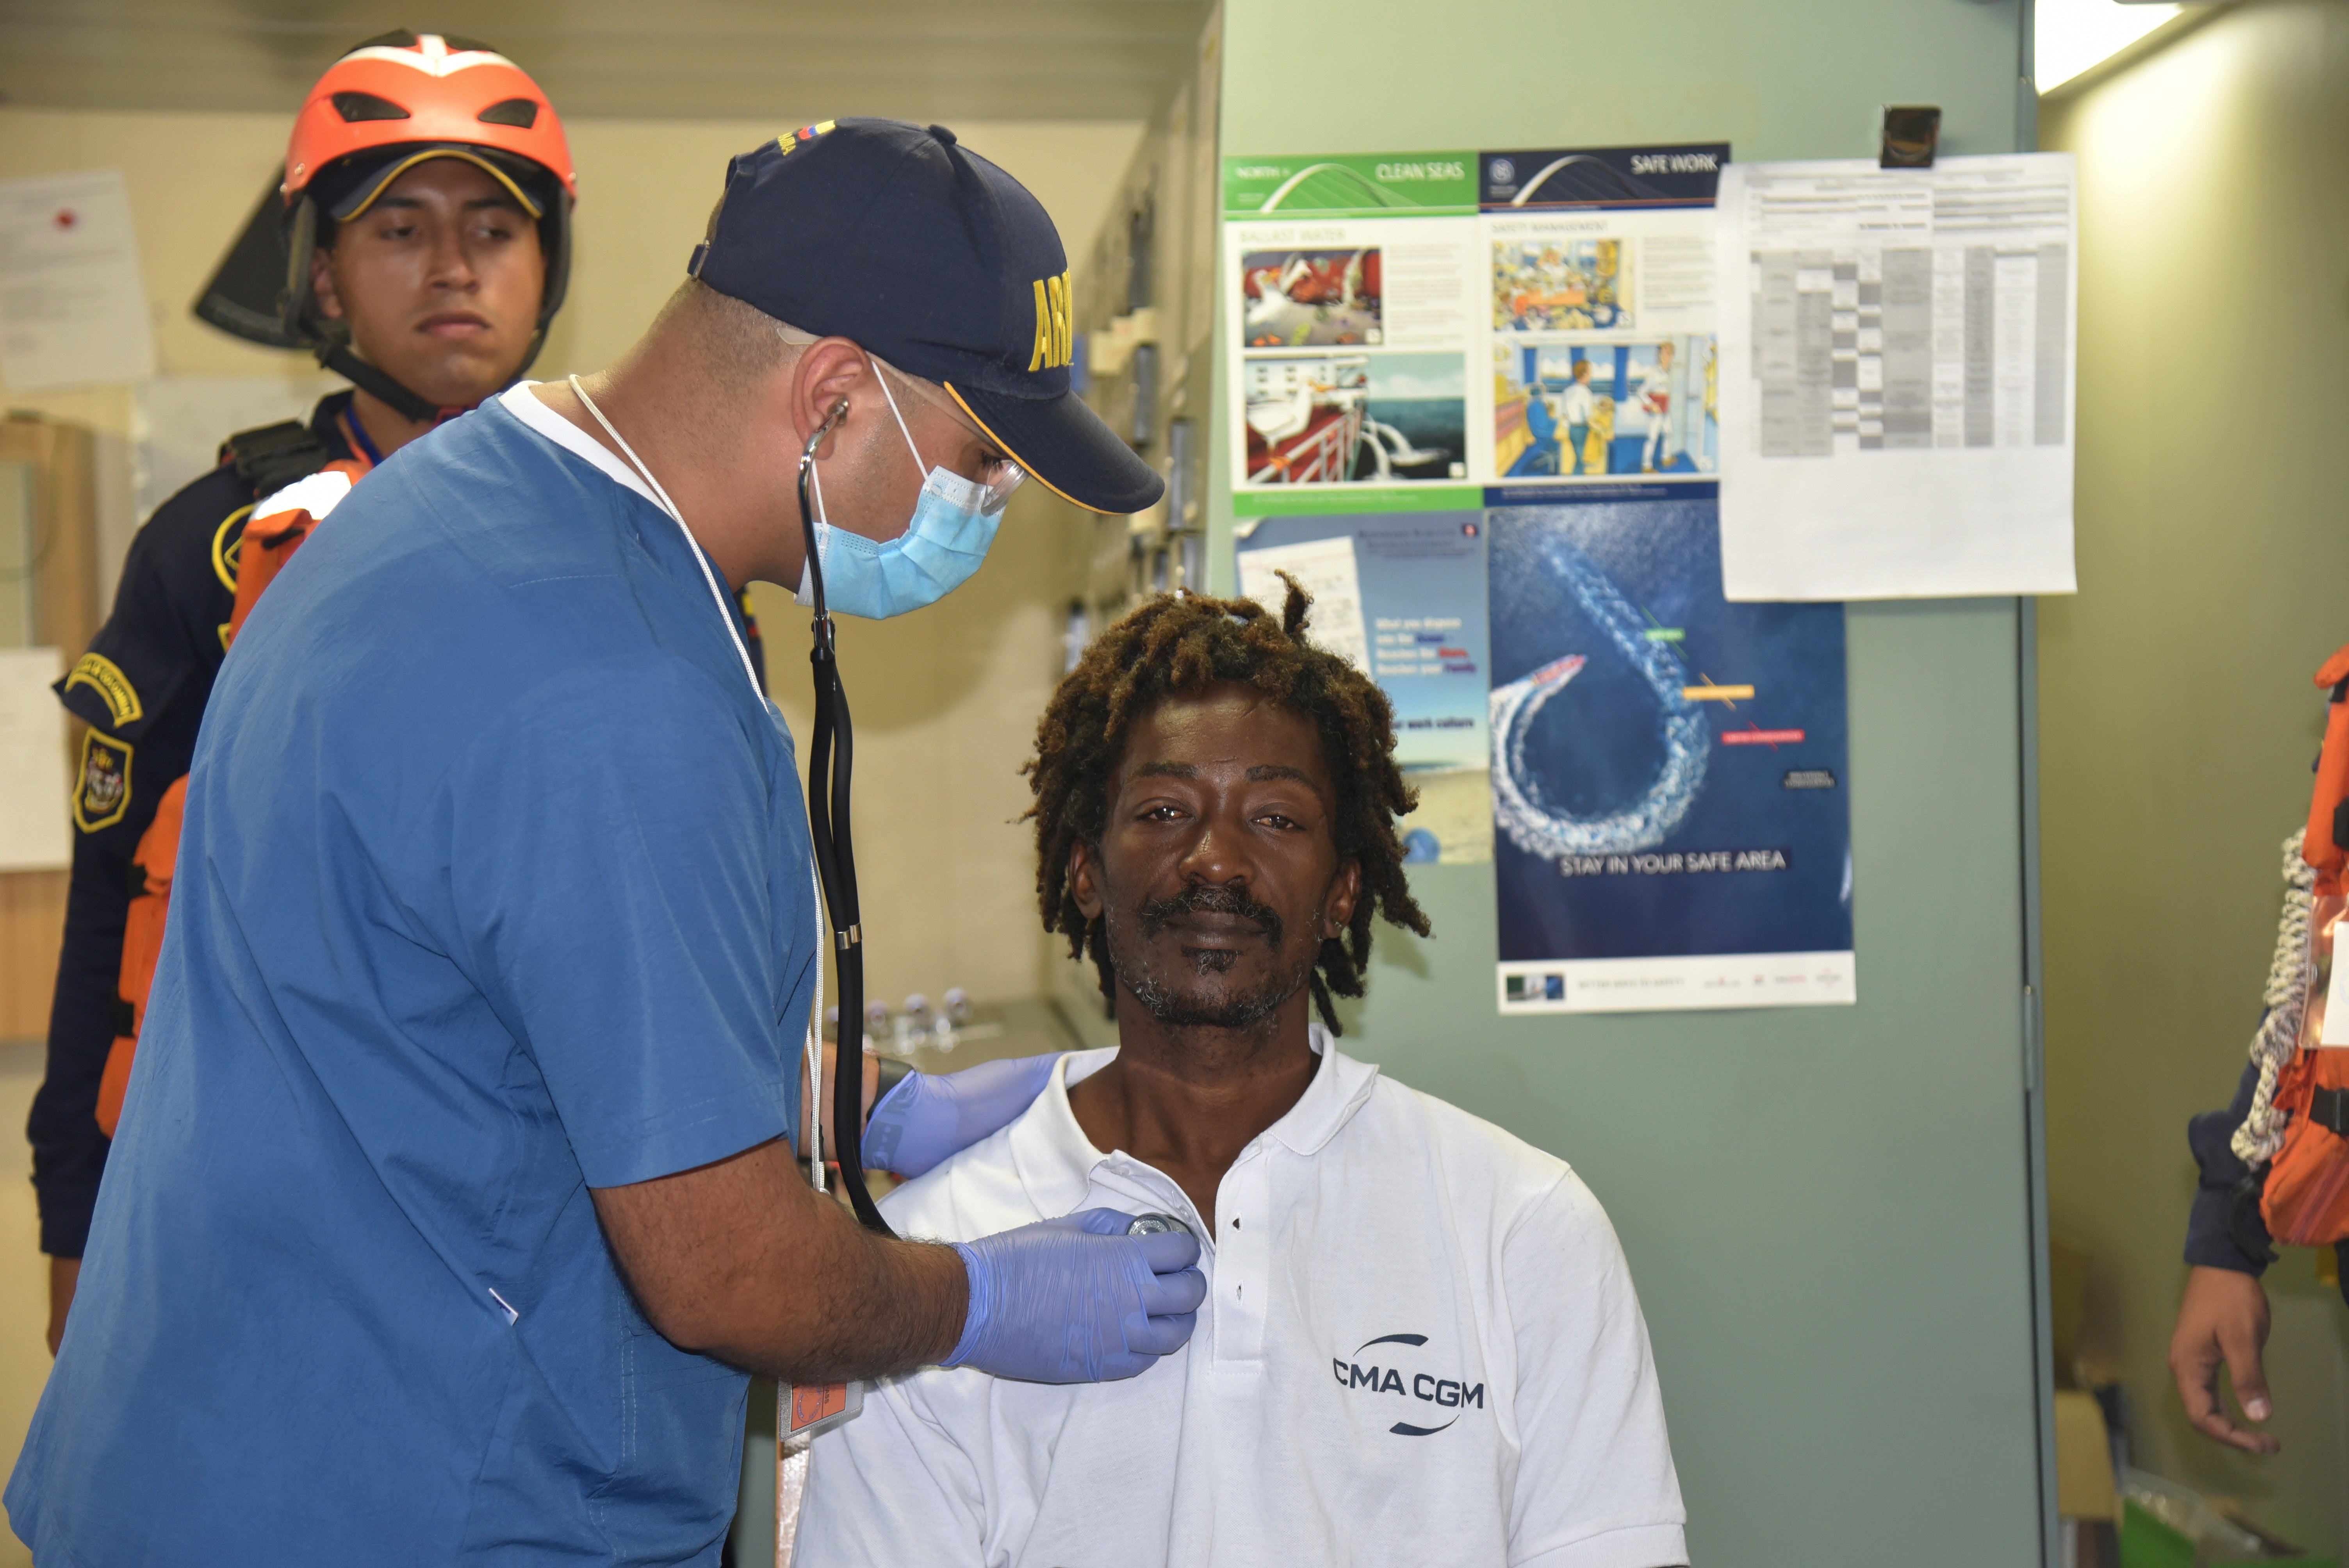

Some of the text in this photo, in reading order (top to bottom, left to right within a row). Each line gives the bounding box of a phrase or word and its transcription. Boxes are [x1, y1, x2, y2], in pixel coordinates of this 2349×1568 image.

[1376, 162, 1465, 182] CLEAN SEAS
[1631, 153, 1718, 175] SAFE WORK
[1561, 850, 1787, 877] STAY IN YOUR SAFE AREA
[1333, 1357, 1484, 1409] CMA CGM
